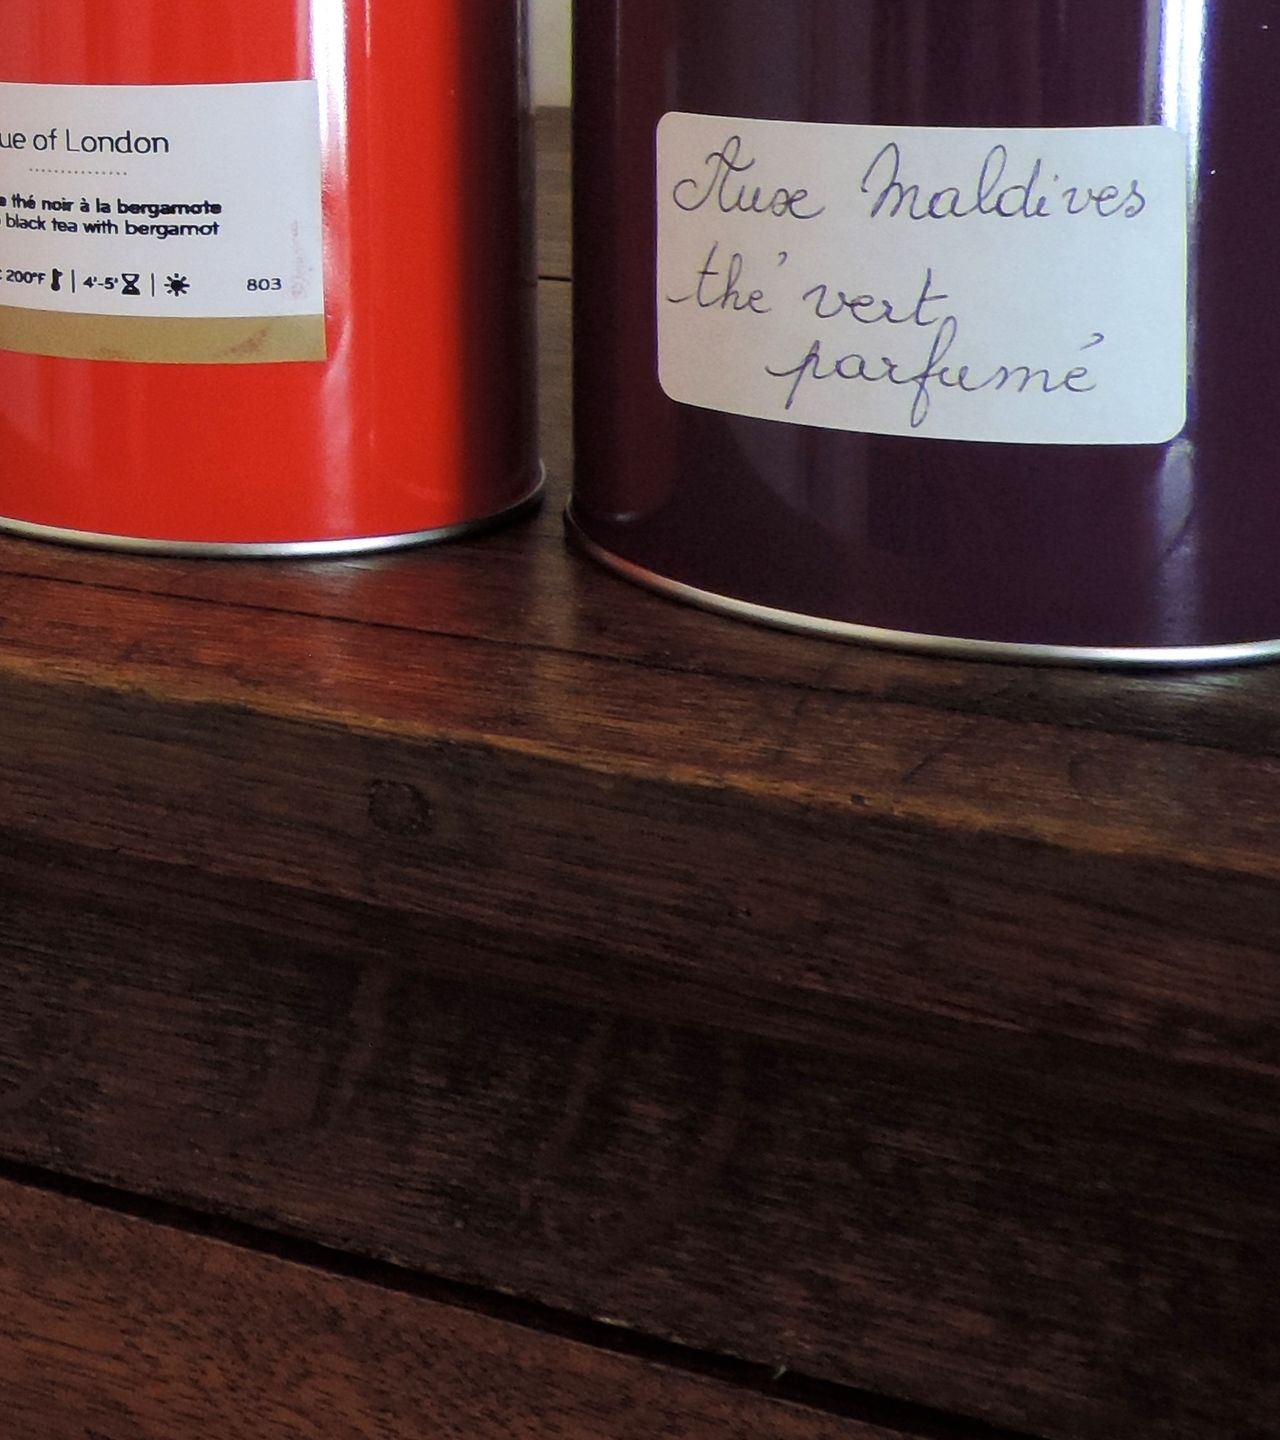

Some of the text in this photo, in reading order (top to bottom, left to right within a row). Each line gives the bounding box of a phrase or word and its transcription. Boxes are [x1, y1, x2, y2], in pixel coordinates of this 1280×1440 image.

[32, 127, 58, 151] of
[65, 129, 170, 154] London
[672, 135, 1147, 222] Aux Maldives
[11, 193, 36, 209] thé
[41, 197, 74, 213] noir
[79, 196, 90, 213] à
[95, 197, 111, 214] la
[117, 198, 222, 218] bergamote
[5, 209, 46, 232] black
[51, 216, 78, 233] tea
[83, 218, 118, 235] with
[125, 220, 220, 239] bergamot
[246, 277, 282, 292] 803
[665, 241, 949, 327] thé vert
[766, 316, 1106, 429] parfumé
